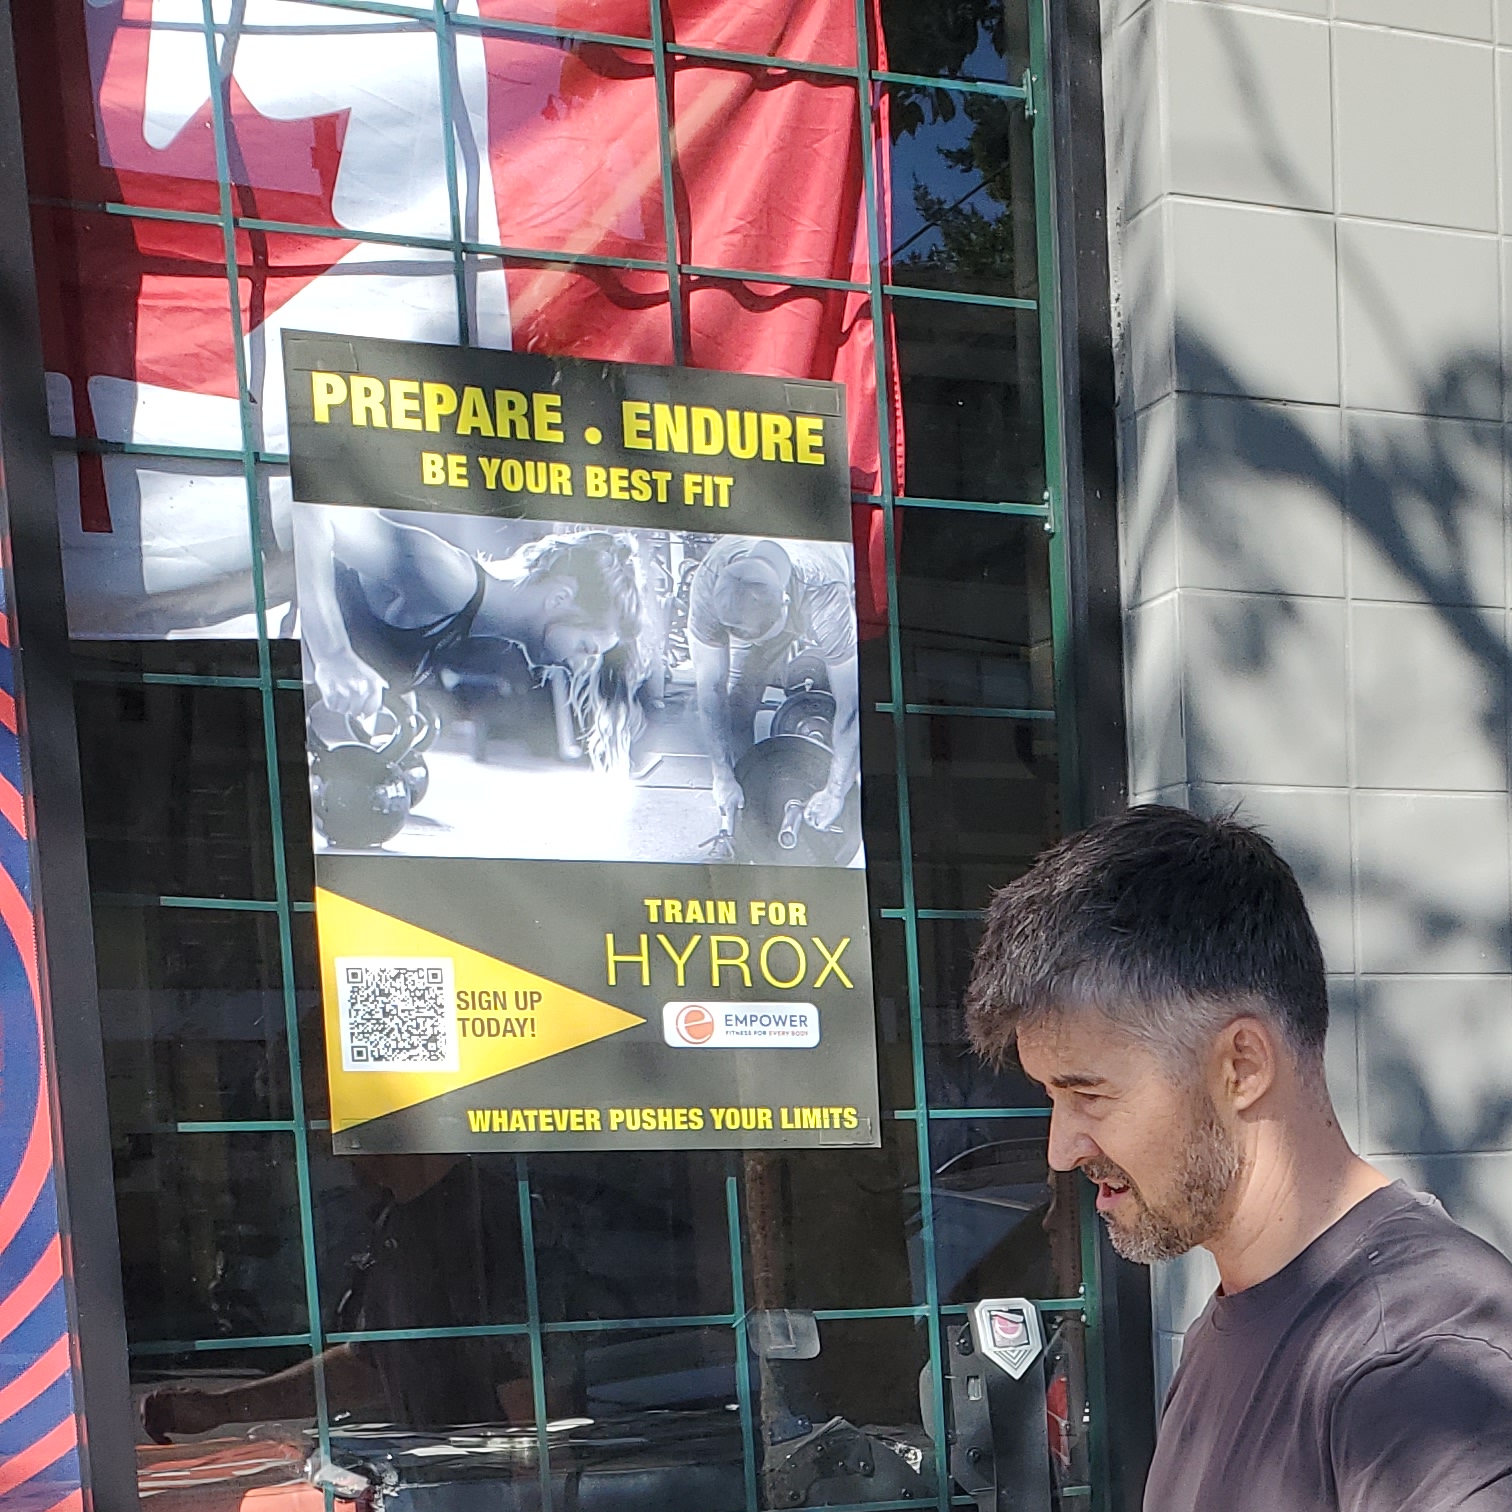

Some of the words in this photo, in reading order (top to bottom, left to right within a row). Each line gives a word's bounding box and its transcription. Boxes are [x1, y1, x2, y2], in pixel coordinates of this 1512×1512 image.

[311, 370, 566, 443] PREPARE
[621, 400, 826, 466] ENDURE
[420, 452, 470, 489] BE
[478, 456, 573, 497] YOUR
[585, 465, 672, 505] BEST
[683, 473, 735, 508] FIT
[644, 898, 737, 925] TRAIN
[750, 900, 809, 926] FOR
[606, 933, 855, 989] HYROX
[456, 990, 508, 1011] SIGN
[514, 990, 543, 1011] UP
[456, 1017, 536, 1038] TODAY!
[724, 1014, 808, 1028] EMPOWER
[467, 1108, 602, 1133] WHATEVER
[609, 1107, 704, 1131] PUSHES
[709, 1107, 773, 1131] YOUR
[780, 1106, 858, 1130] LIMITS
